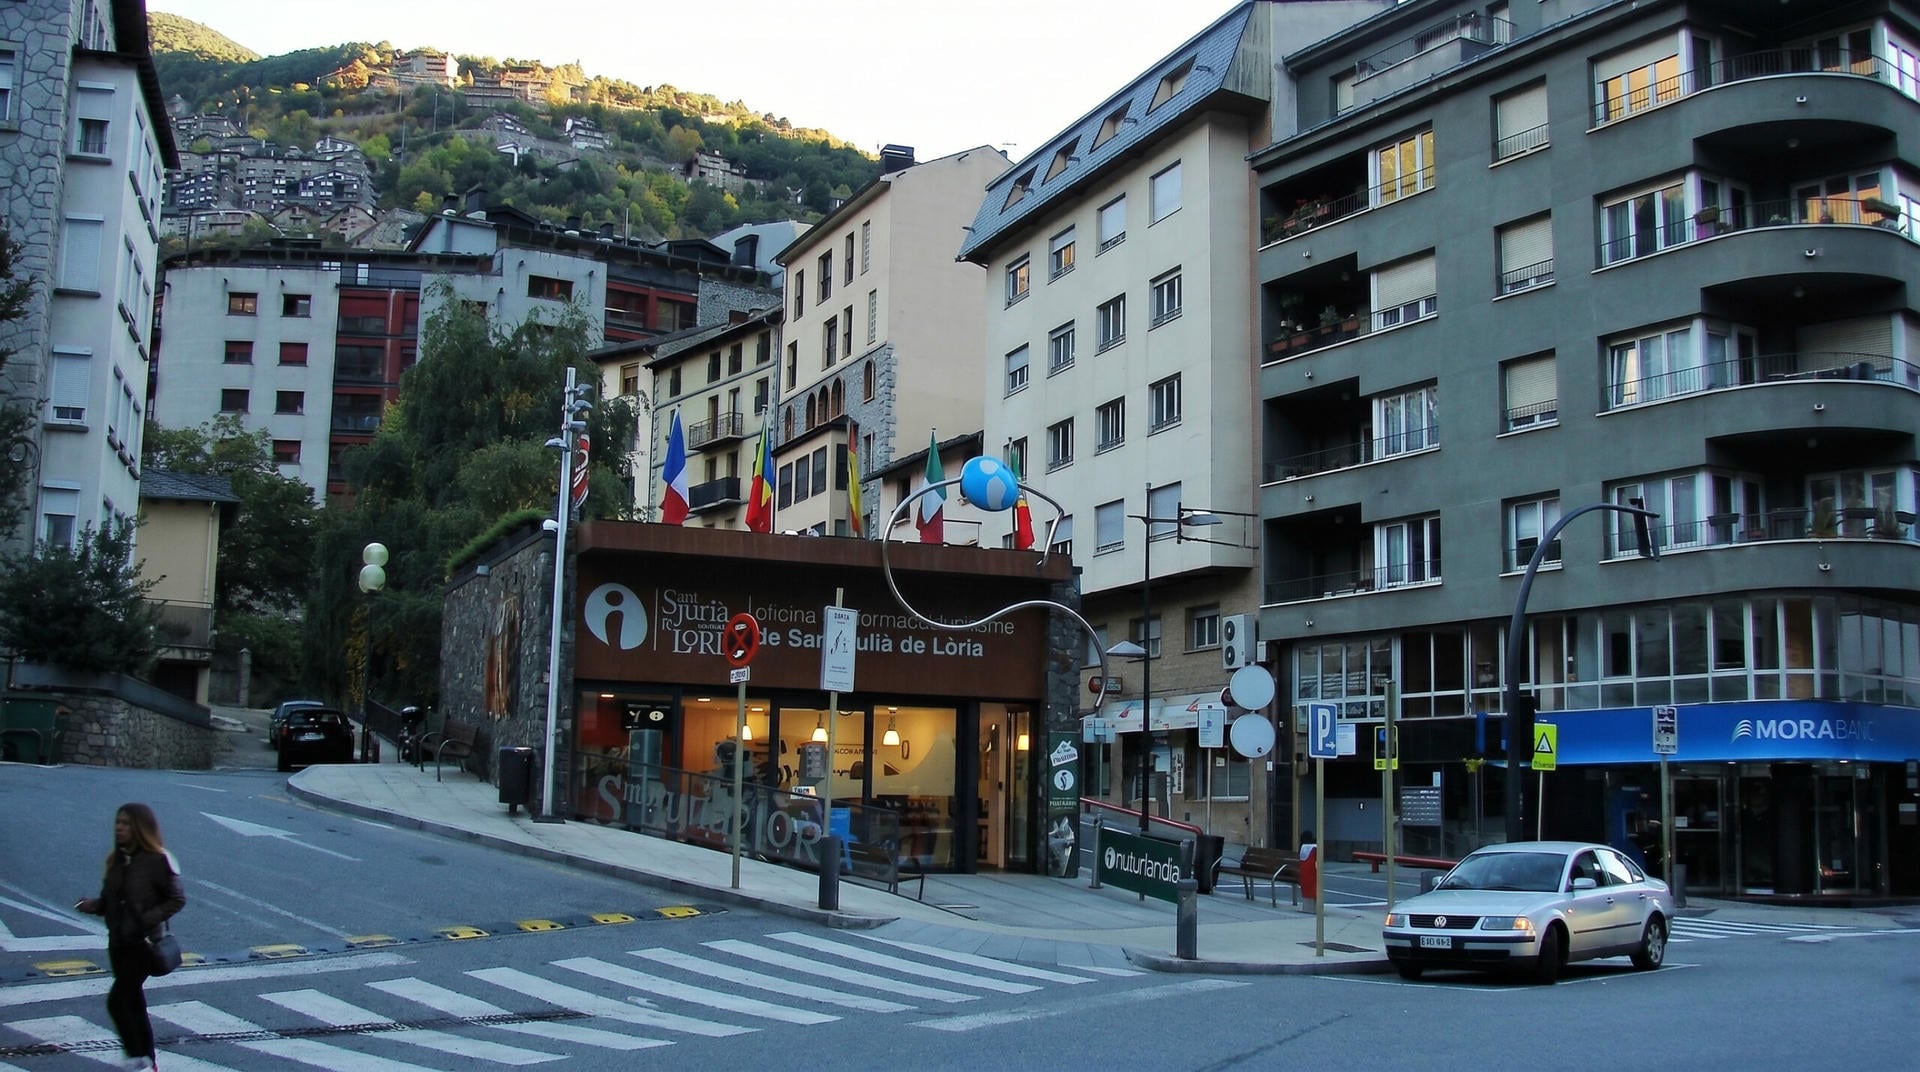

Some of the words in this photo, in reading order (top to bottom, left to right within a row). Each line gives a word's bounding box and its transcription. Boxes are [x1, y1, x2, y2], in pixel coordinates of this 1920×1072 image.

[756, 604, 816, 625] oficina
[856, 632, 893, 653] ulià
[900, 635, 926, 654] de
[933, 636, 984, 657] Lòria
[1317, 708, 1331, 752] P
